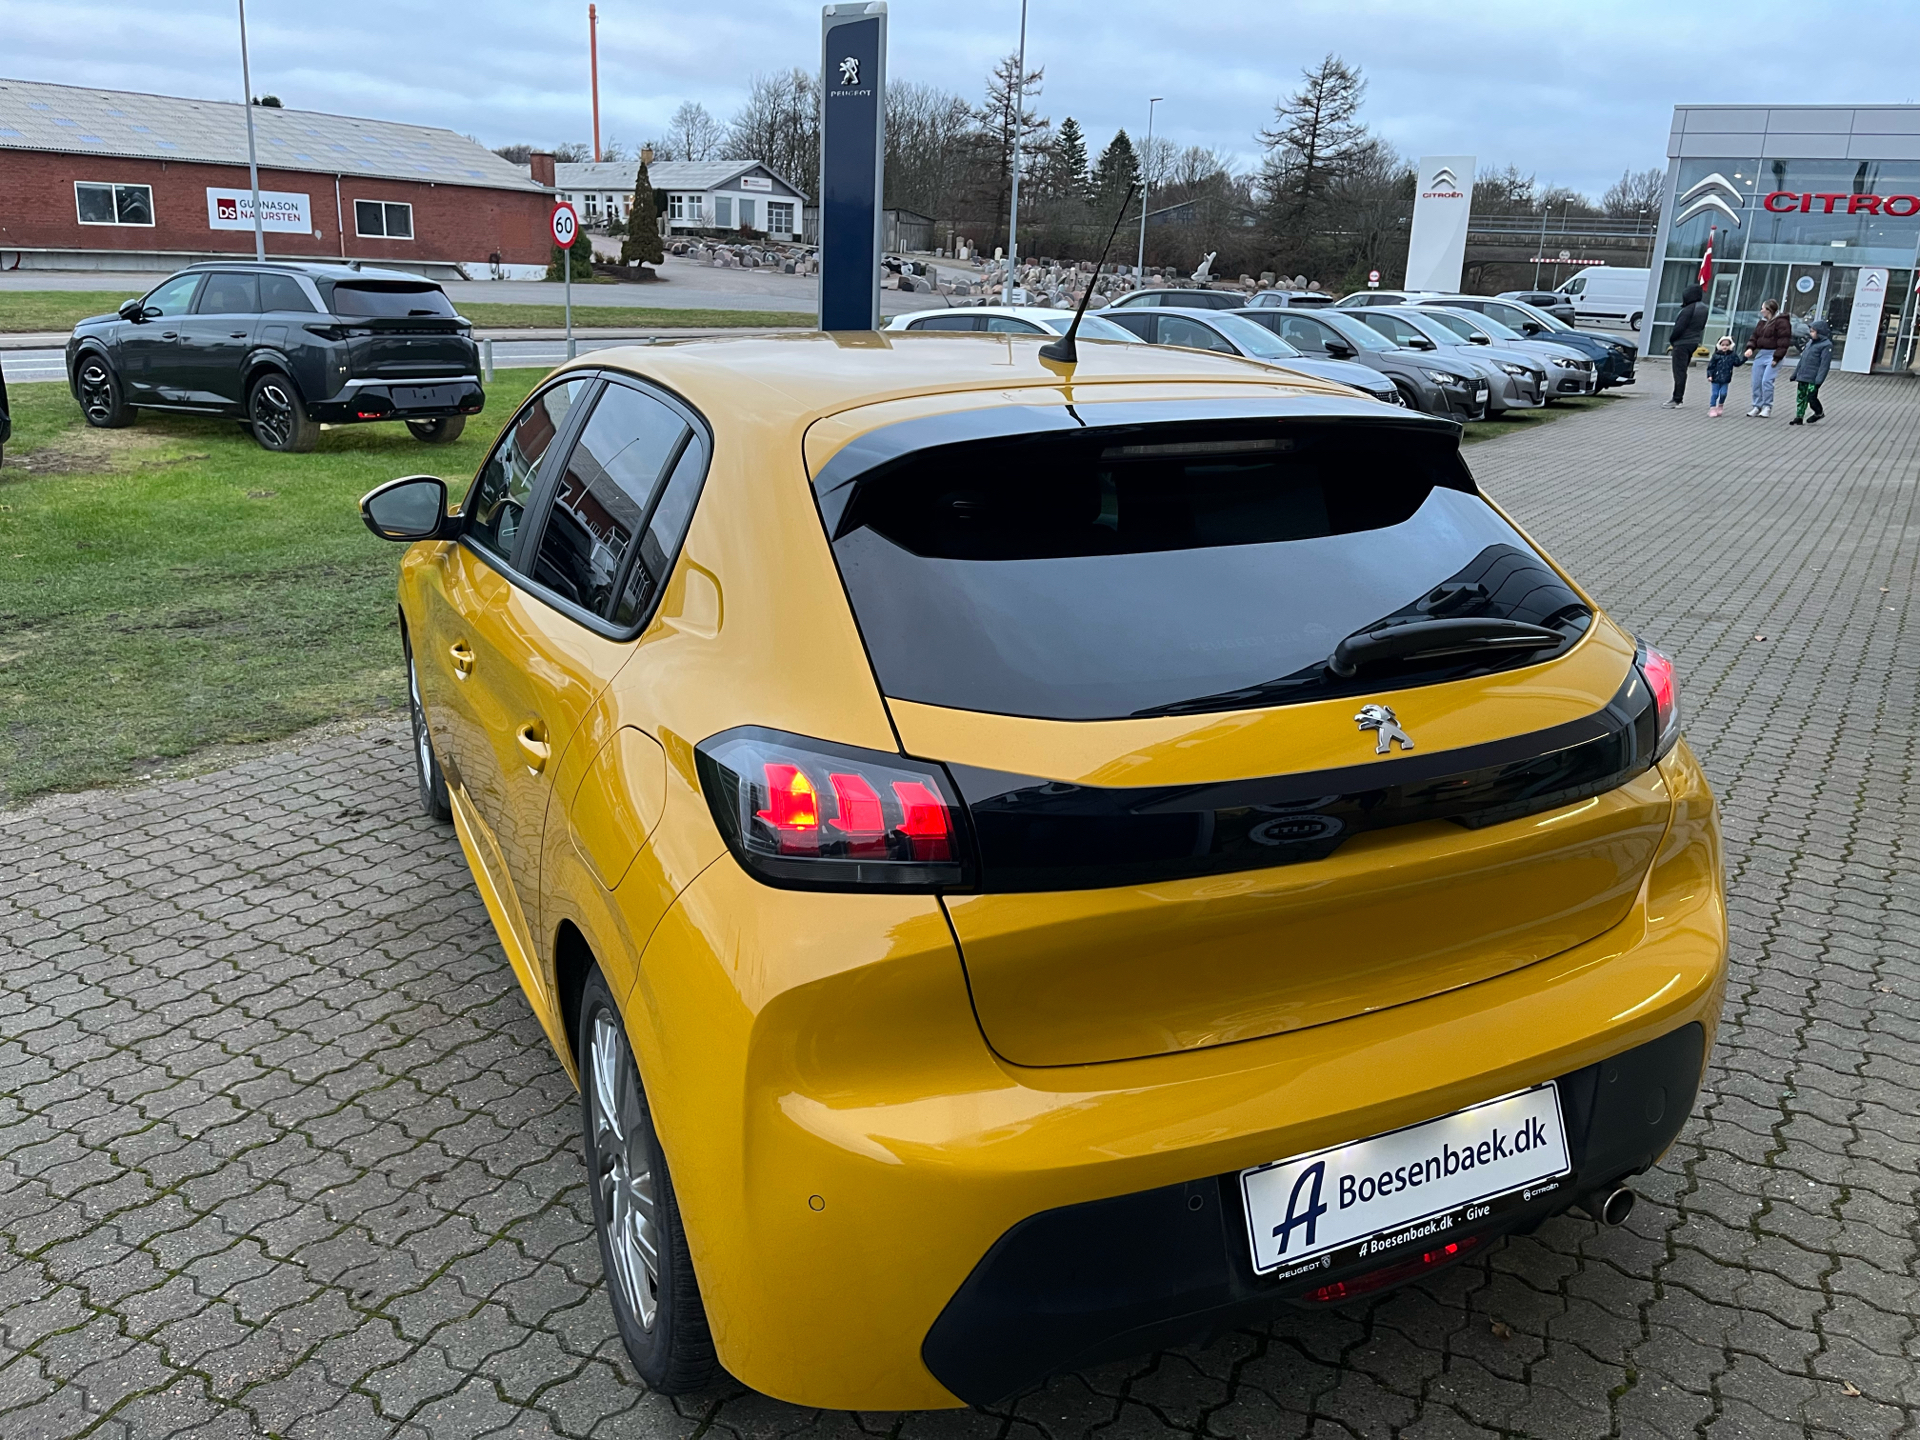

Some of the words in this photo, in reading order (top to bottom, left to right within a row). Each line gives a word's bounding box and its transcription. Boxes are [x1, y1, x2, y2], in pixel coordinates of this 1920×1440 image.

[219, 207, 236, 219] DS
[239, 199, 298, 211] GUNASON
[240, 210, 301, 222] NAURSTEN
[556, 216, 573, 234] 60
[1339, 1116, 1548, 1210] Boesenbaek.dk
[1370, 1216, 1453, 1254] Boesenbaek.dk
[1466, 1205, 1491, 1221] Give
[1278, 1261, 1320, 1280] PEUGEOT
